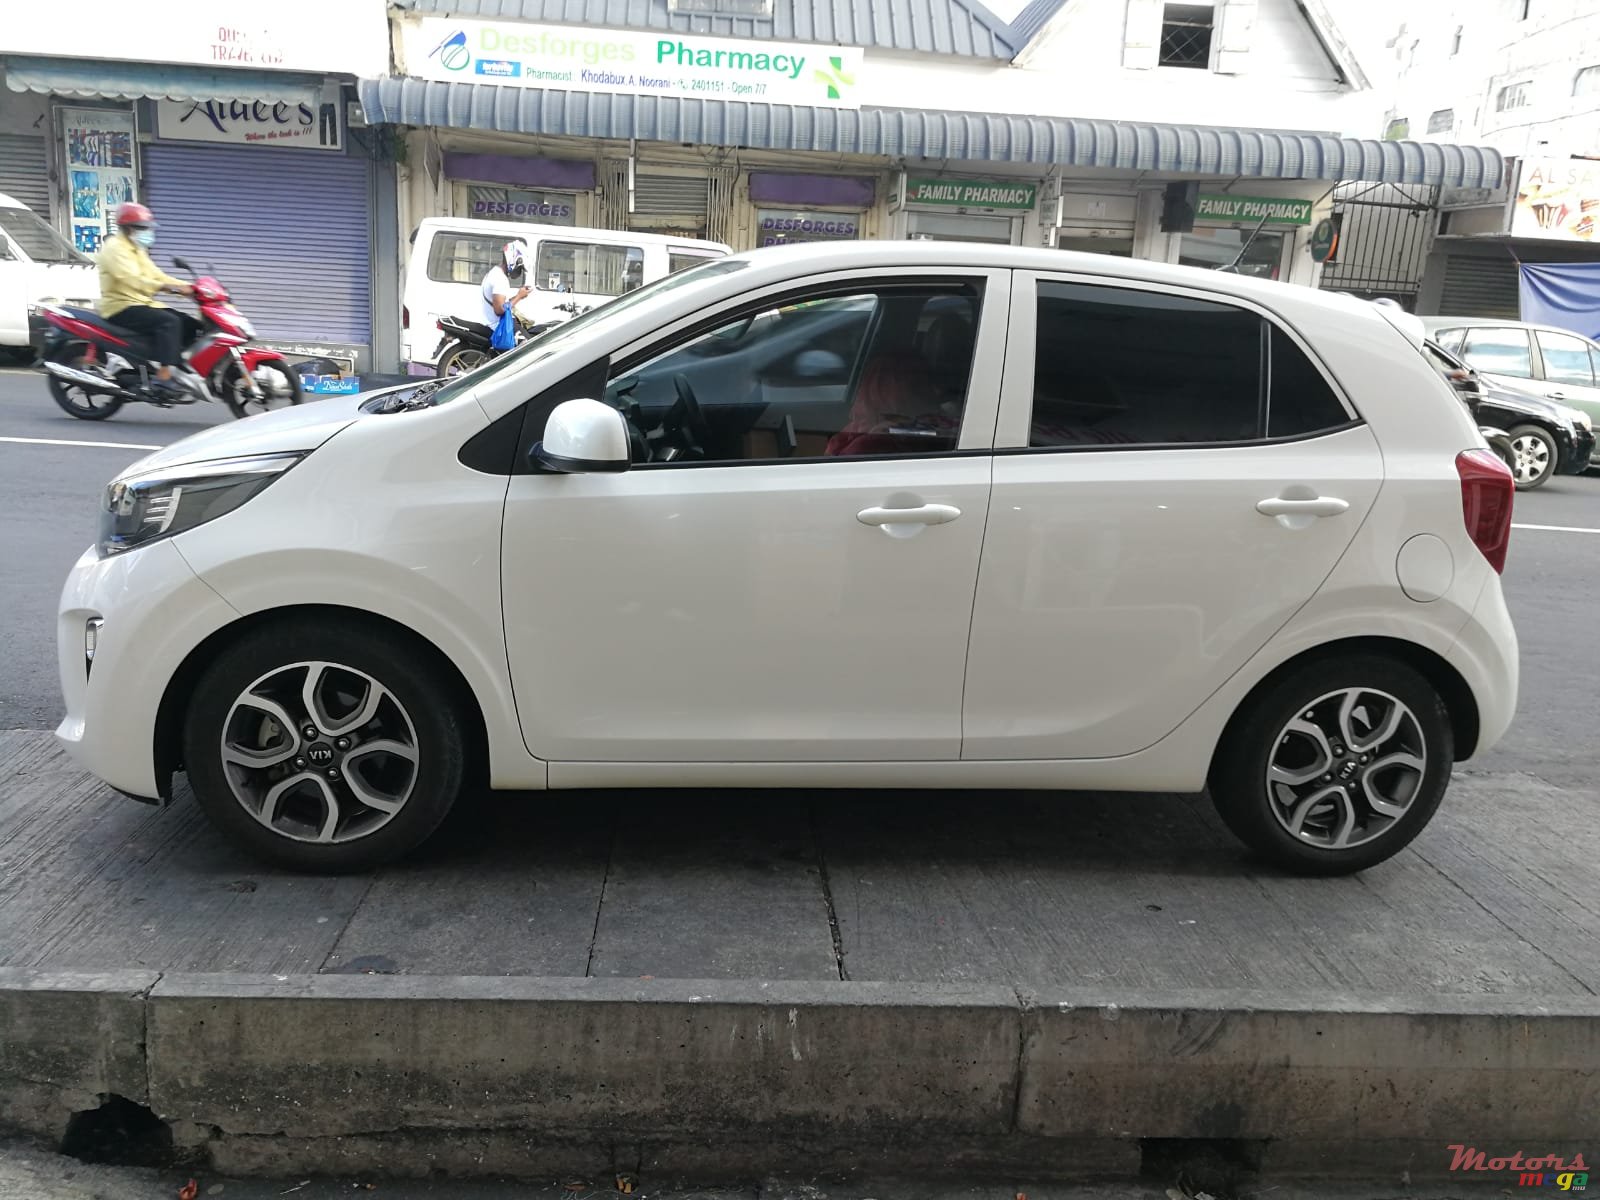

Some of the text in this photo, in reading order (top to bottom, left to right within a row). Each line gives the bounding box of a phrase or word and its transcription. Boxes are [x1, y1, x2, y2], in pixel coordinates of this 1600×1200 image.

[479, 27, 805, 79] Desforges Pharmacy
[639, 76, 671, 89] Noorani
[691, 79, 724, 93] 2401151
[731, 82, 753, 96] Open
[754, 82, 767, 95] 7/7
[917, 184, 1033, 205] FAMILY PHARMACY
[475, 201, 570, 217] DESFORGES
[1198, 199, 1310, 220] FAMILY PHARMACY
[763, 218, 855, 234] DESFORGES
[309, 749, 332, 760] KIA
